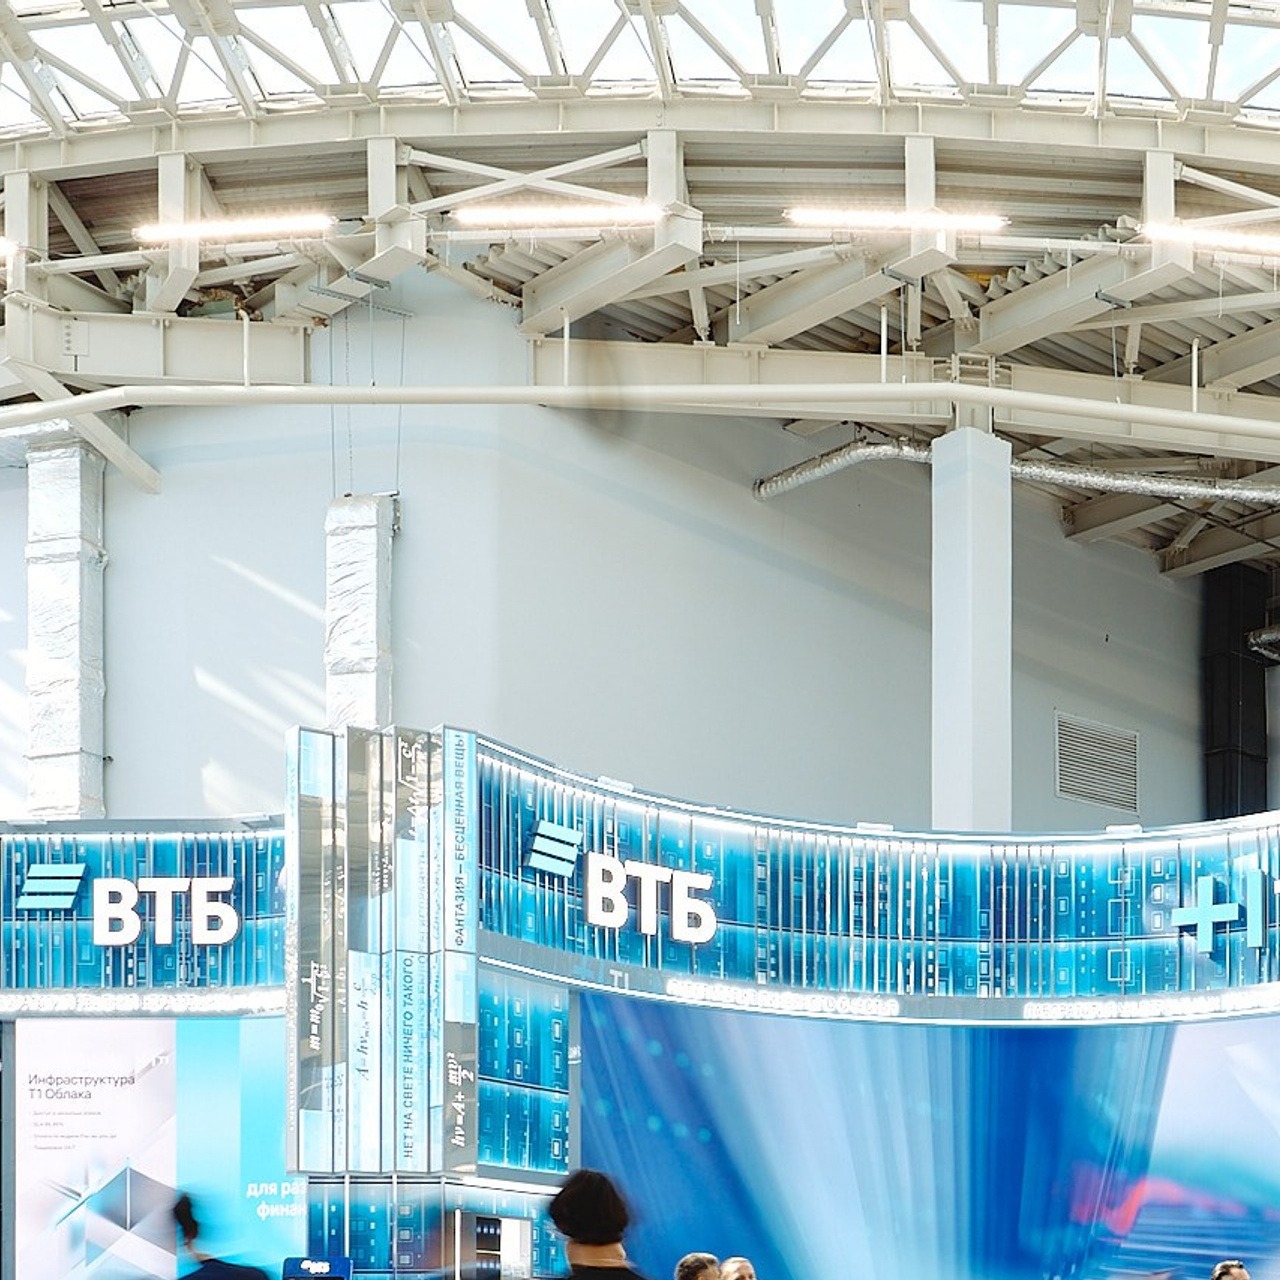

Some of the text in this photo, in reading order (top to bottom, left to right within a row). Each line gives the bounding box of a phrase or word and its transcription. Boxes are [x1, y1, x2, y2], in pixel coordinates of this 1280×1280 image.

[453, 734, 466, 778] ВЕЩЬ!
[453, 781, 467, 861] БЕСЦЕННАЯ
[92, 877, 240, 946] ВТБ
[453, 876, 466, 947] ФАНТАЗИЯ
[583, 850, 718, 944] ВТБ
[28, 1073, 136, 1087] Инфраструктура
[403, 955, 415, 1159] НЕТ НА СВЕТЕ НИЧЕГО ТАКОГО,
[45, 1087, 92, 1100] Облака
[247, 1181, 278, 1198] для
